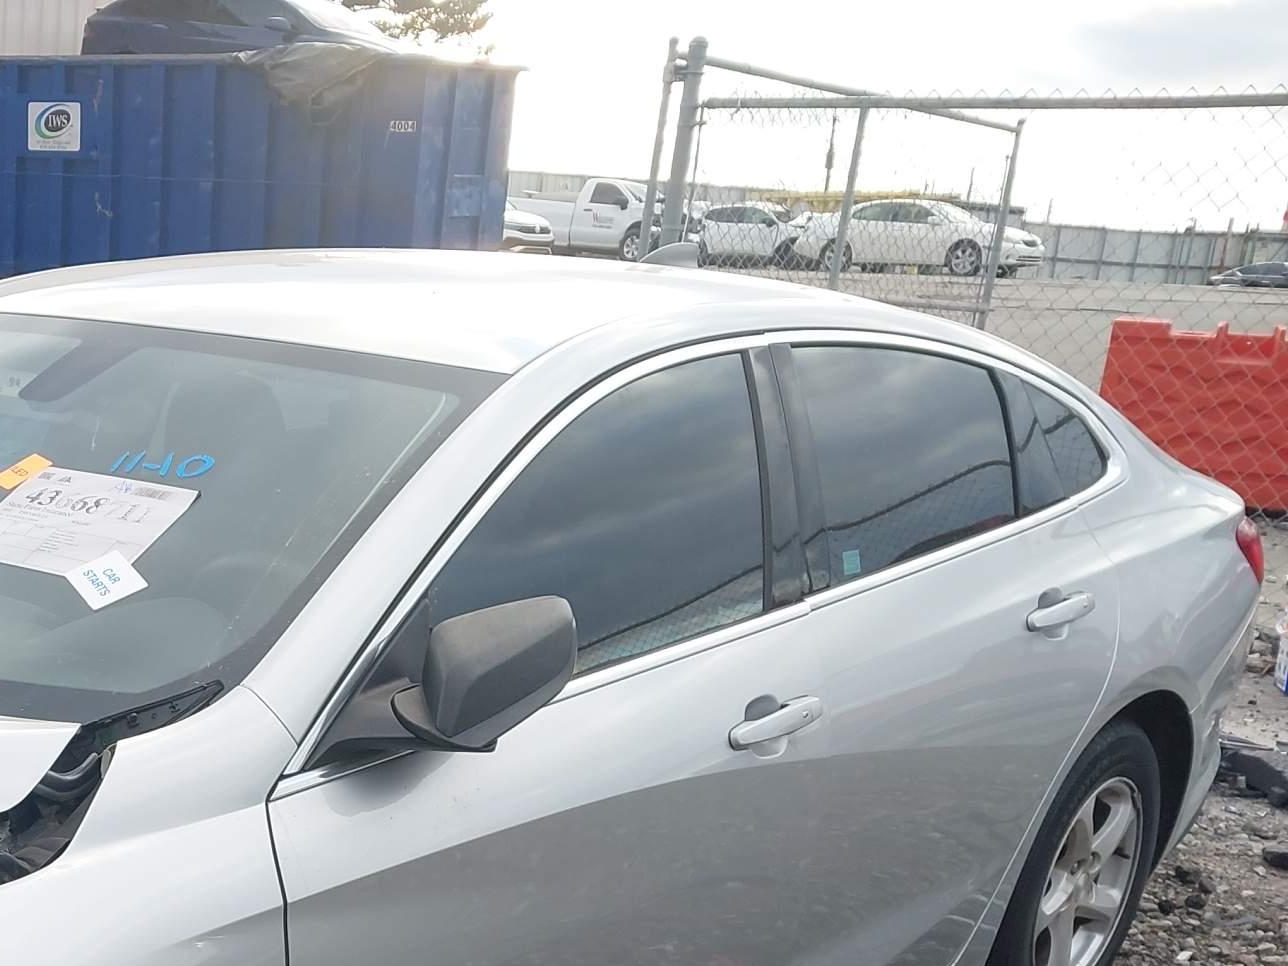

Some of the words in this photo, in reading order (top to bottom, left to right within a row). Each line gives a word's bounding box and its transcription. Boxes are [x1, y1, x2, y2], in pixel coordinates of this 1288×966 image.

[47, 114, 68, 128] IWS
[391, 121, 416, 131] 4004
[111, 450, 215, 478] 11-10
[82, 569, 111, 596] STARTS
[103, 568, 121, 584] CAR
